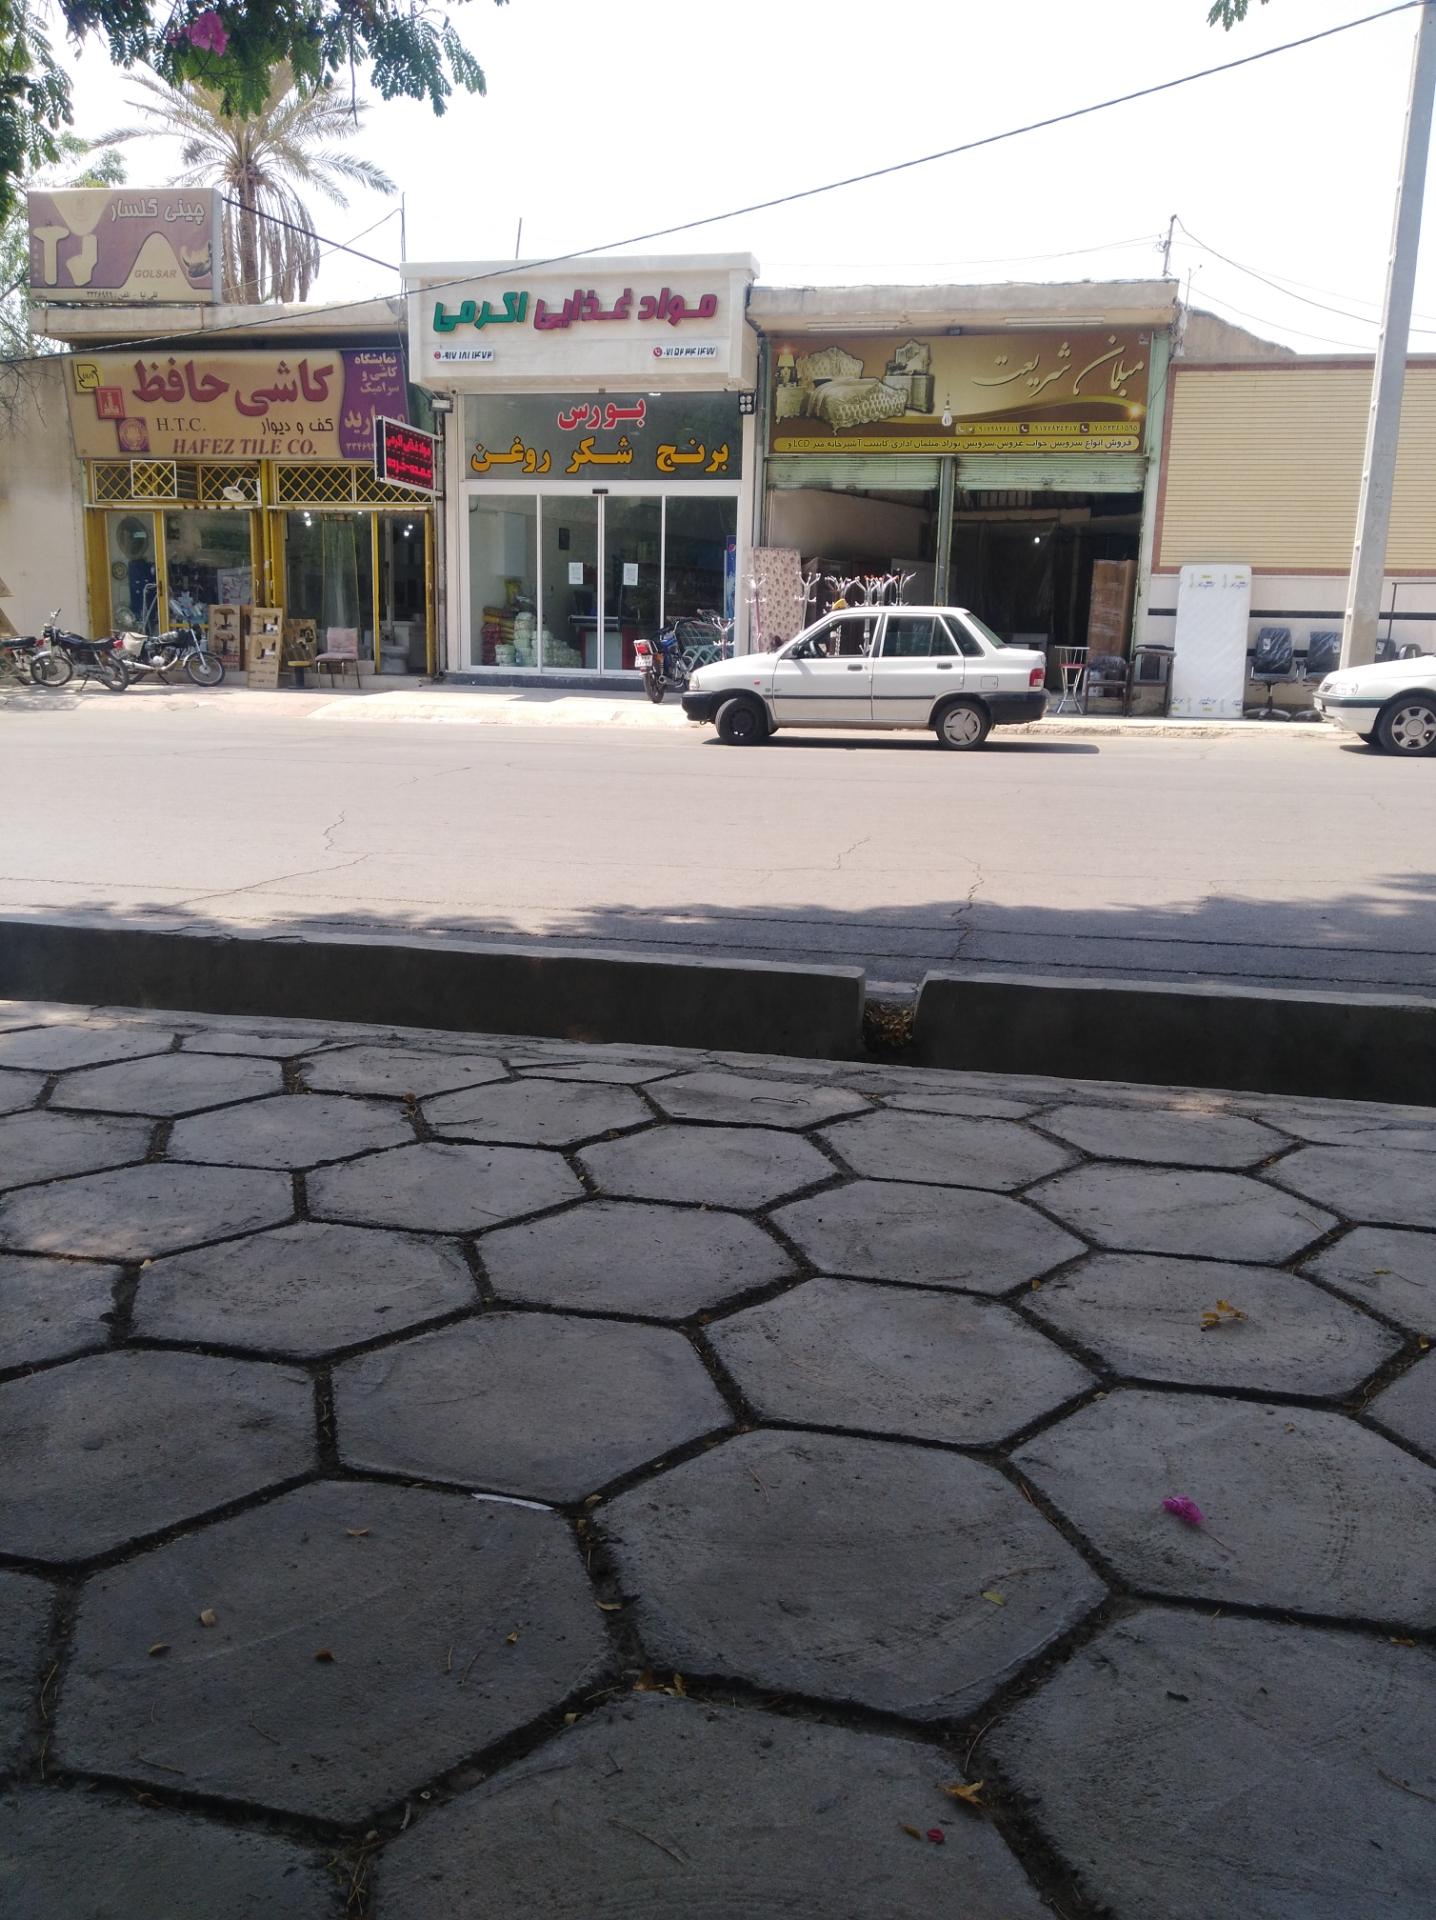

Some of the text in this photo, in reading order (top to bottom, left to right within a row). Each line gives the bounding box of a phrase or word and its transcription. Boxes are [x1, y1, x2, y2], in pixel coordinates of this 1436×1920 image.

[111, 198, 205, 225] چینی گلسار
[134, 268, 177, 278] GOLSAR
[432, 287, 718, 333] مواد غذایی اکرمی
[354, 351, 397, 367] نمایشگاه
[971, 334, 1145, 398] مبلمان شریعت
[361, 366, 398, 381] کاشی و
[132, 357, 334, 417] کاشی حافظ
[360, 381, 400, 396] سرامیک
[557, 398, 647, 431] بورس
[156, 417, 206, 432] H.T.C.
[261, 417, 334, 435] کف و دیوار
[172, 438, 318, 455] HAFEZ TILE CO.
[793, 439, 810, 448] LCD
[1026, 439, 1047, 448] خواب
[1049, 439, 1083, 450] سرویس
[1084, 439, 1103, 450] انواع
[1105, 439, 1132, 449] فروش
[470, 435, 730, 474] برنج شکر روغن
